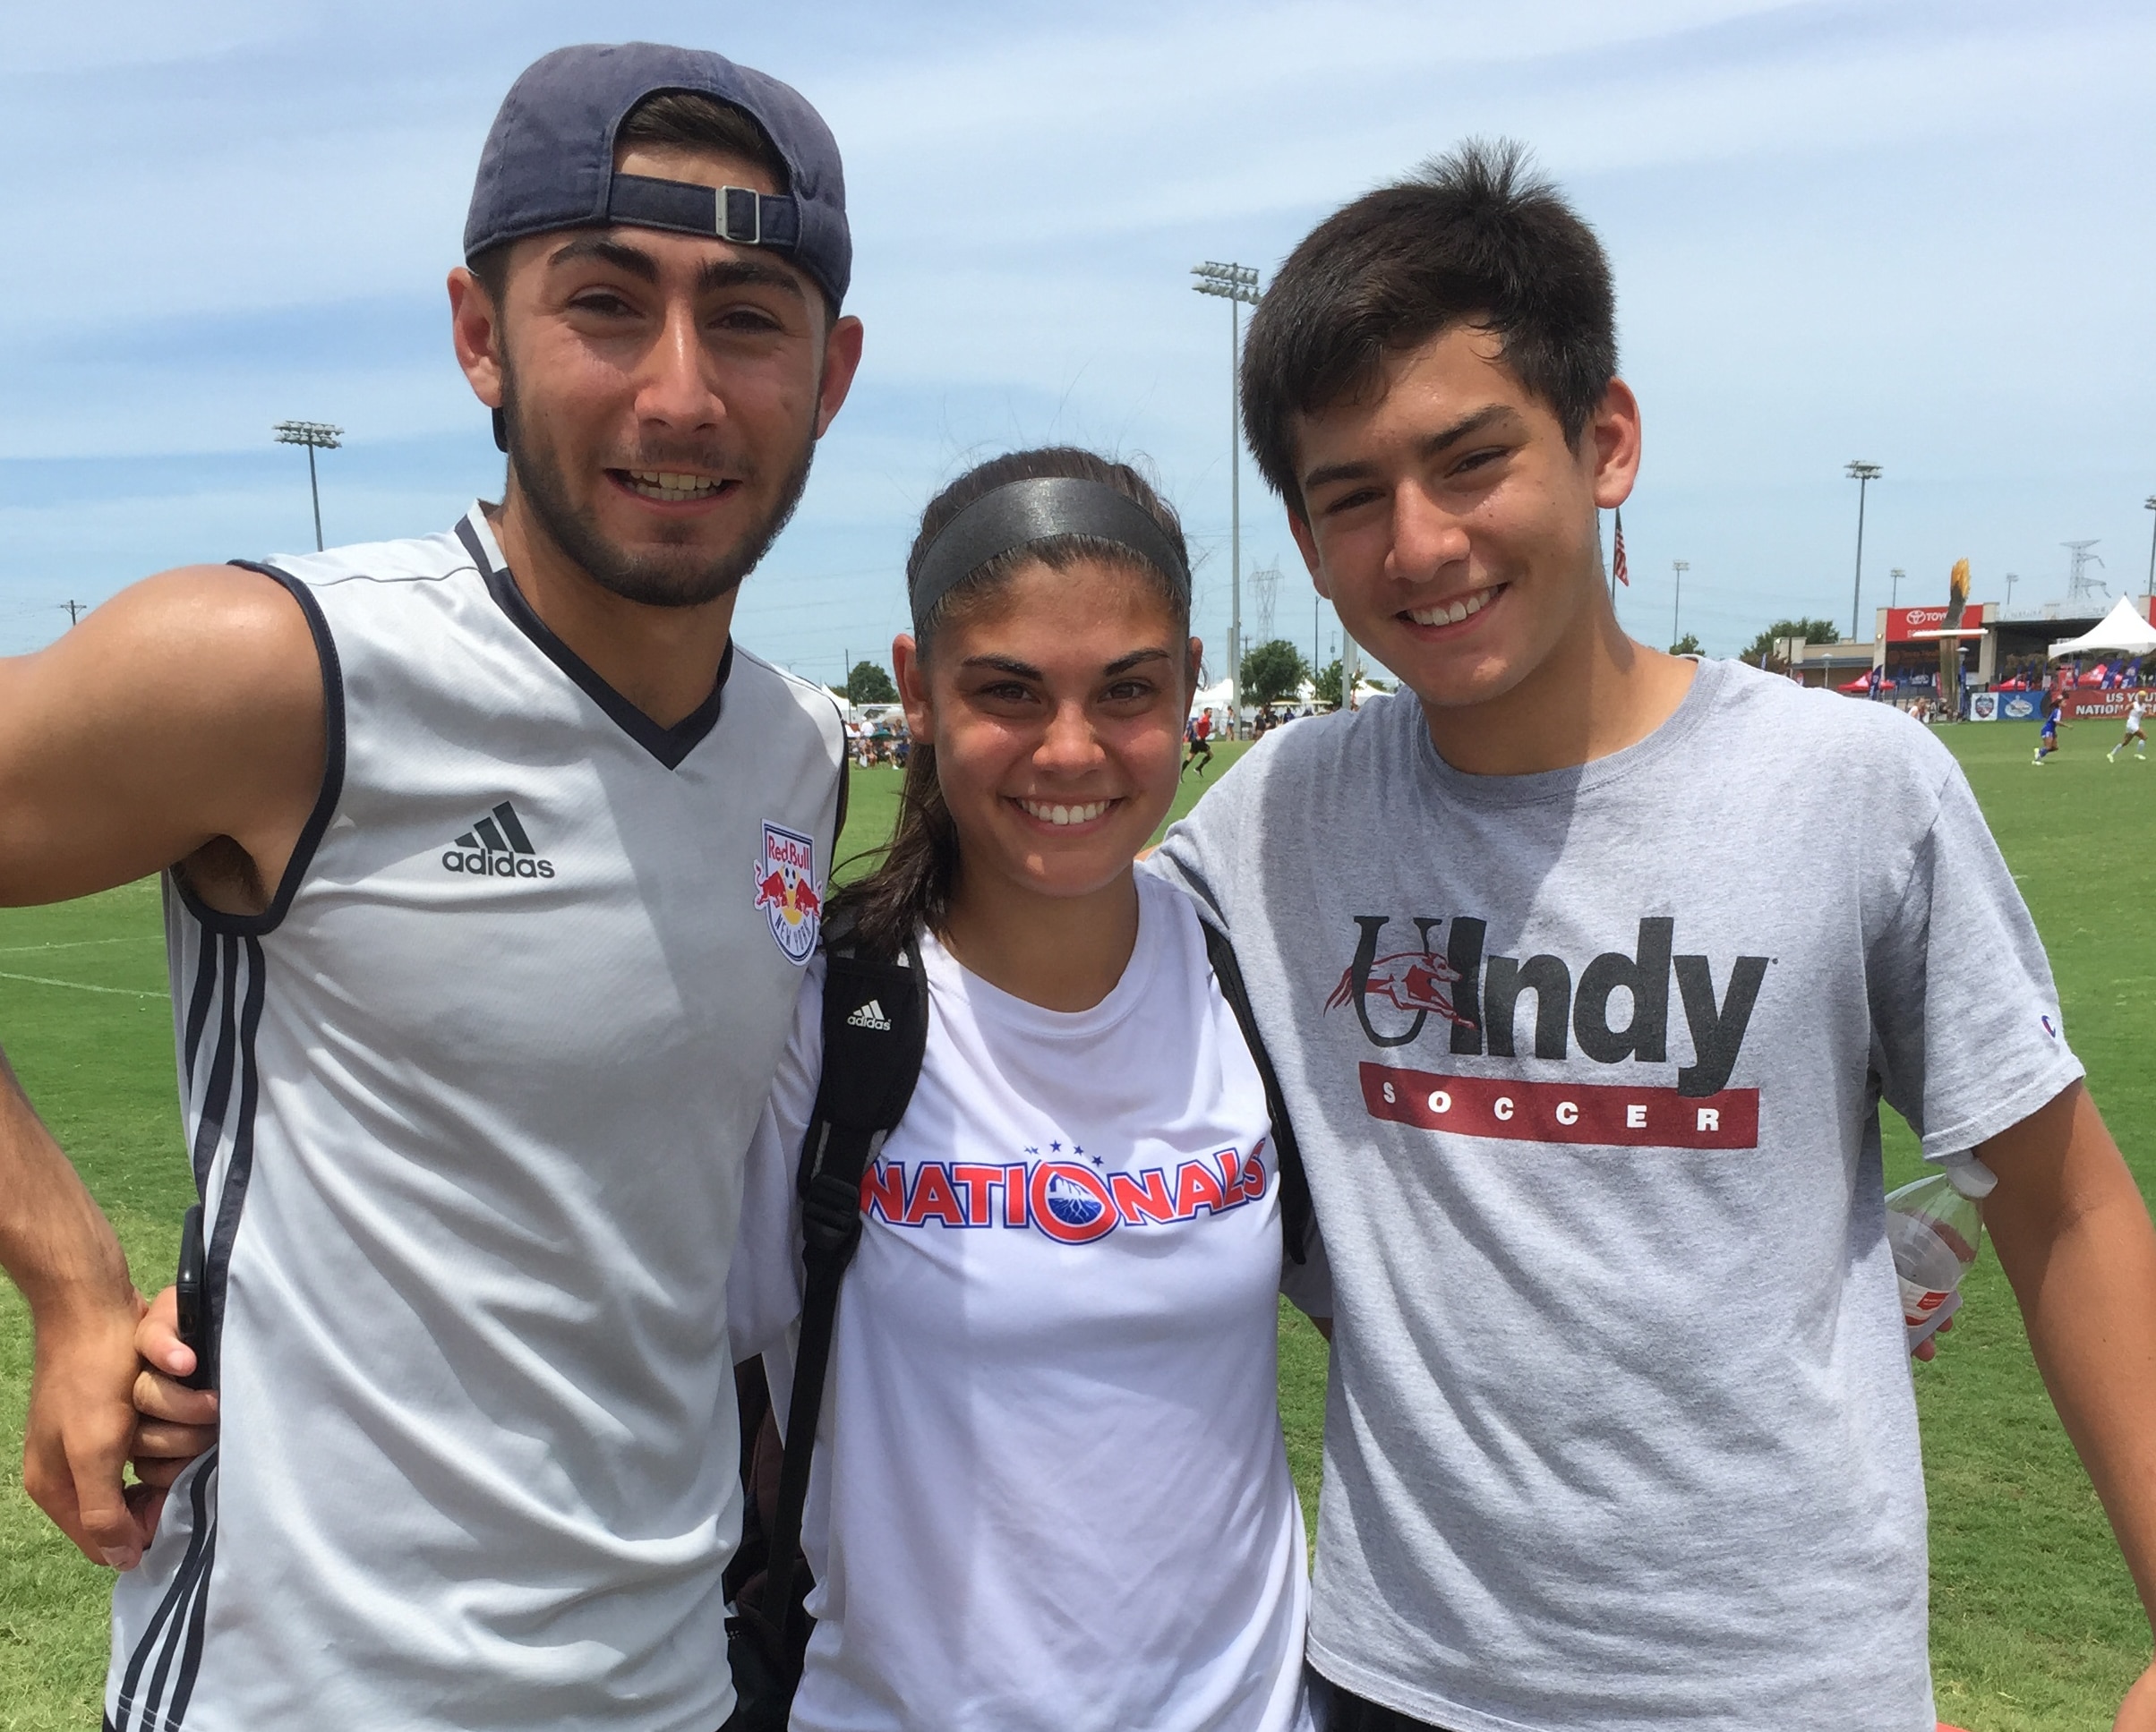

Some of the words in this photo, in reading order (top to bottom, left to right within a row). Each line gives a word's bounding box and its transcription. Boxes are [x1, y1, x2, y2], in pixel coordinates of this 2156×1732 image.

[2106, 692, 2124, 703] US
[442, 848, 555, 879] adidas
[768, 834, 788, 862] Red
[790, 842, 810, 871] Bull
[774, 913, 791, 949] NEW
[793, 918, 812, 952] YORK
[847, 1015, 891, 1031] adidas
[1353, 916, 1769, 1098] UIndy
[1382, 1080, 1720, 1132] SOCCER
[860, 1137, 1267, 1246] NATIONALS
